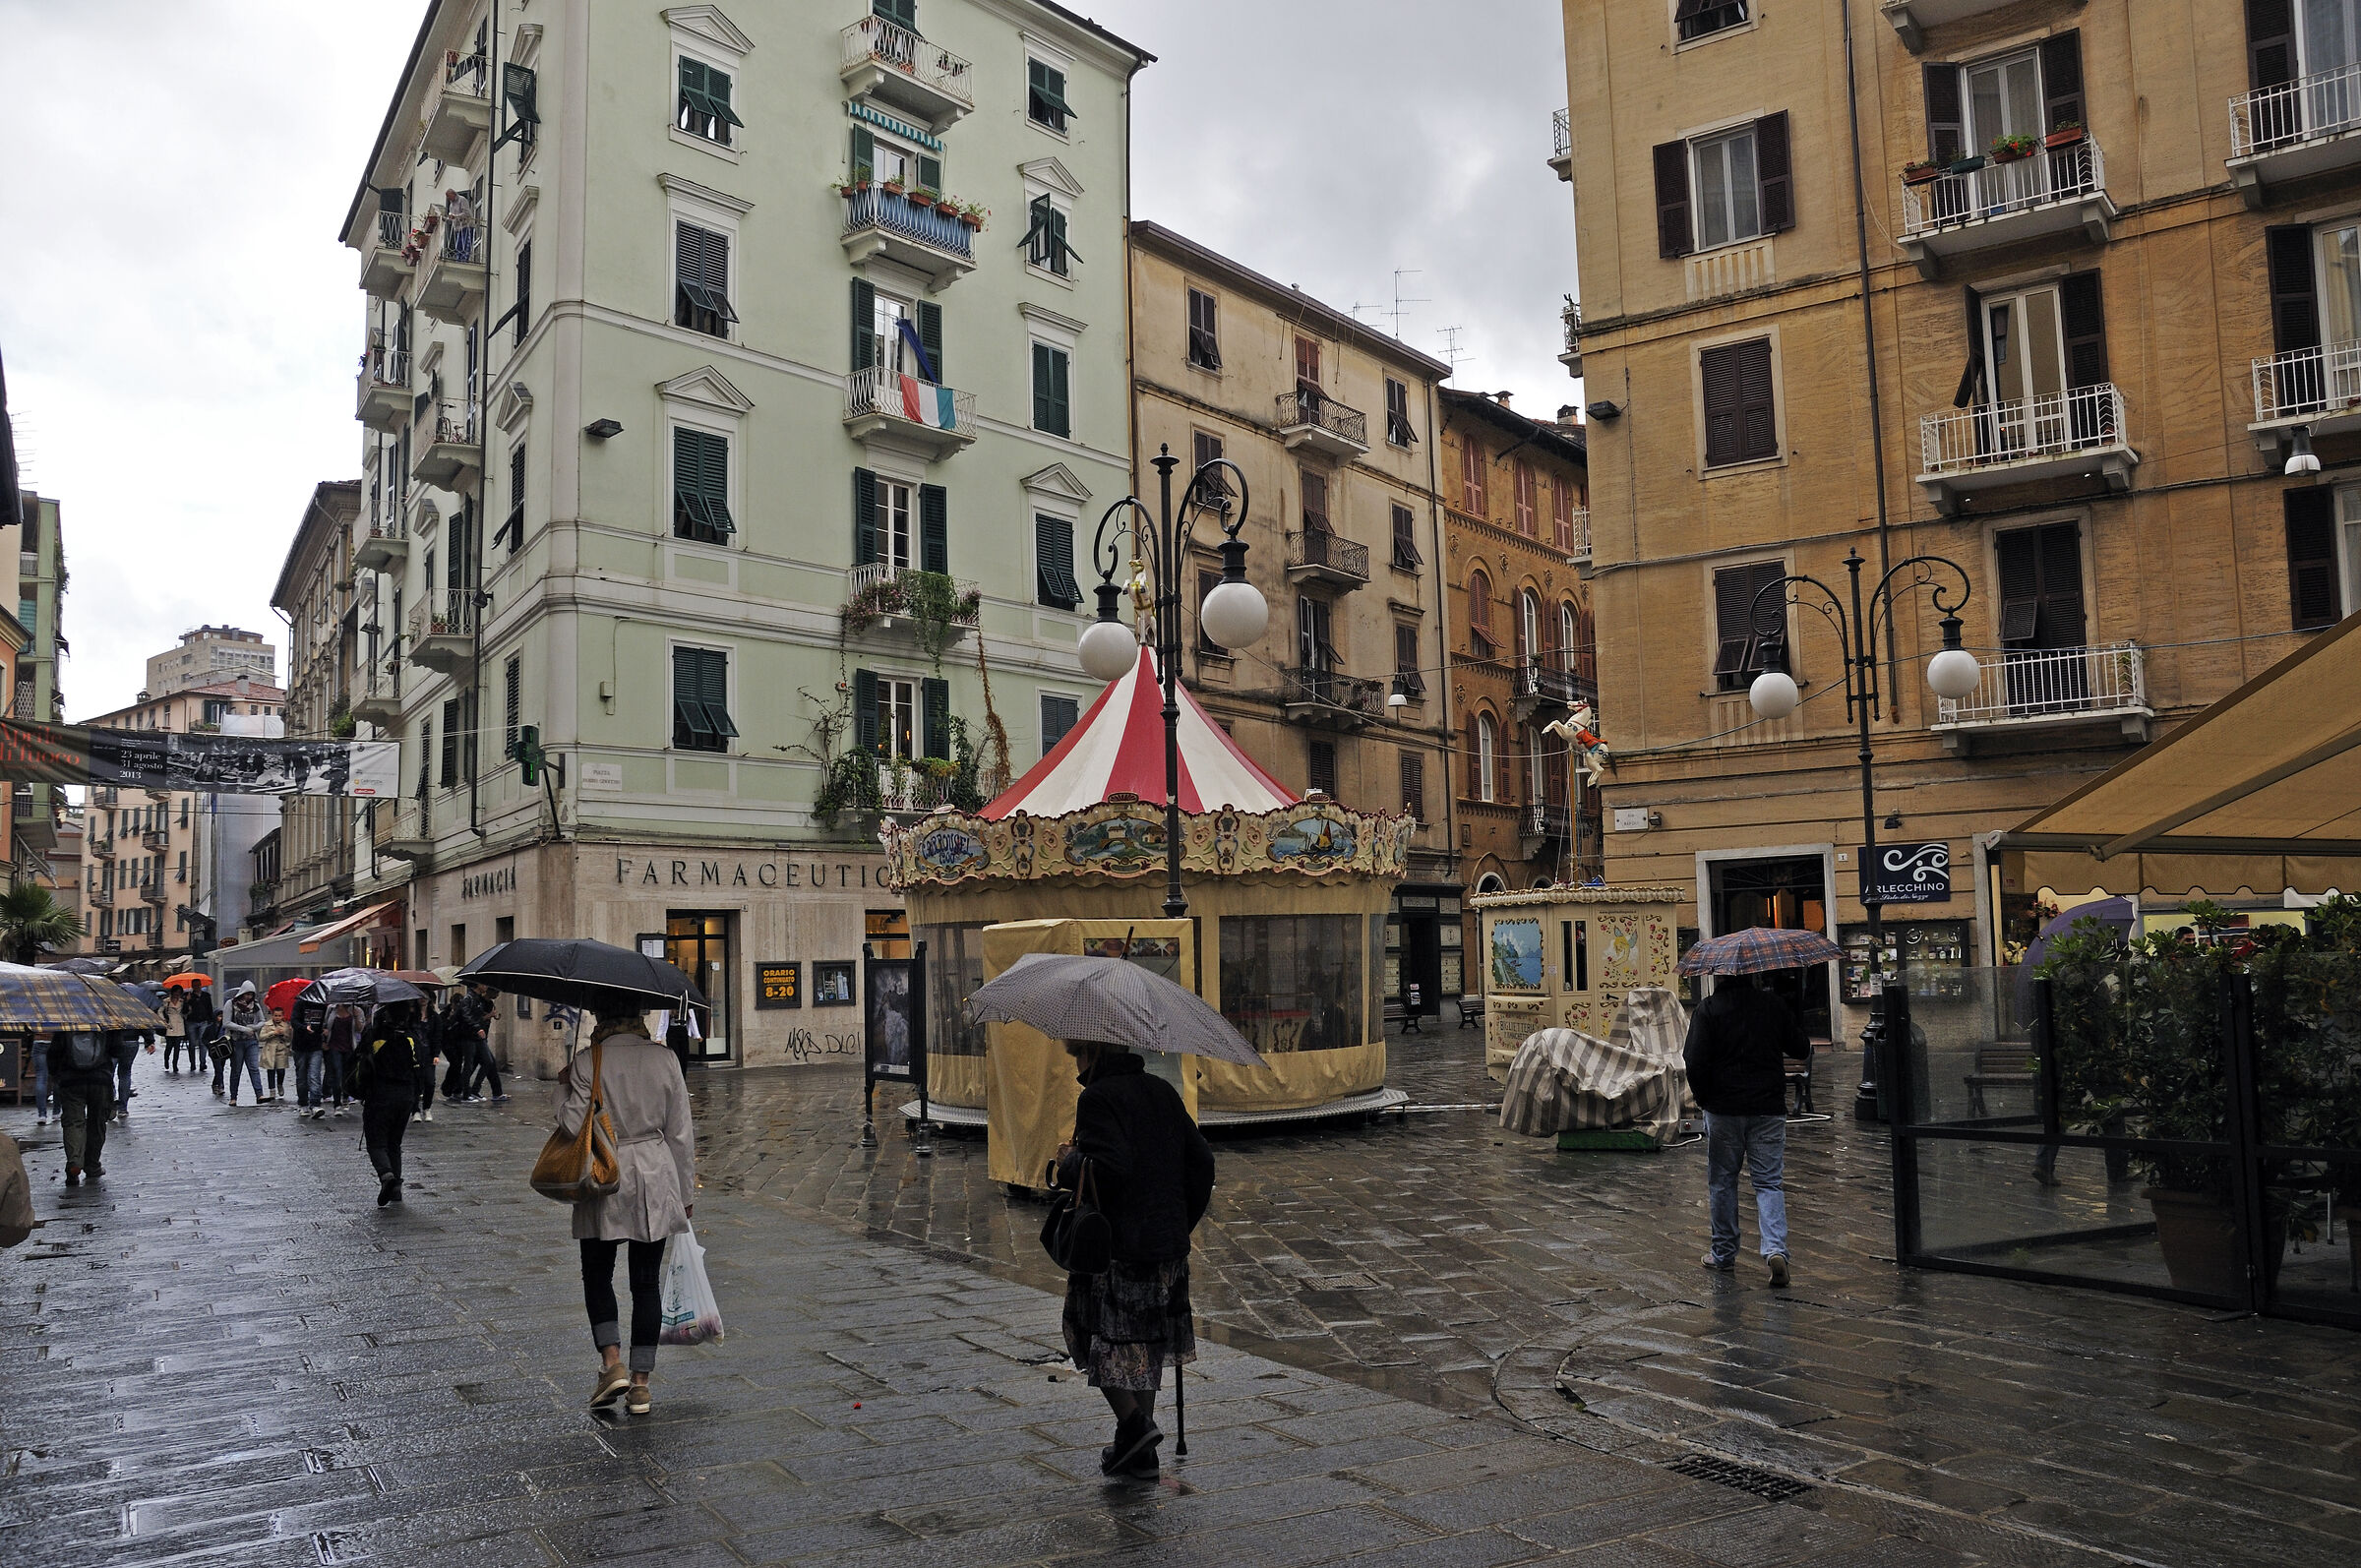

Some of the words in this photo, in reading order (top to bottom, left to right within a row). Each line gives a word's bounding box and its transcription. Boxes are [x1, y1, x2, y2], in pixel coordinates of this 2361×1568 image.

[120, 750, 133, 758] 23
[134, 752, 161, 761] aprile
[120, 759, 132, 768] 31
[133, 762, 163, 771] agosto
[119, 770, 142, 779] 2013
[461, 866, 516, 901] FARMACIA
[765, 986, 794, 997] 8-20
